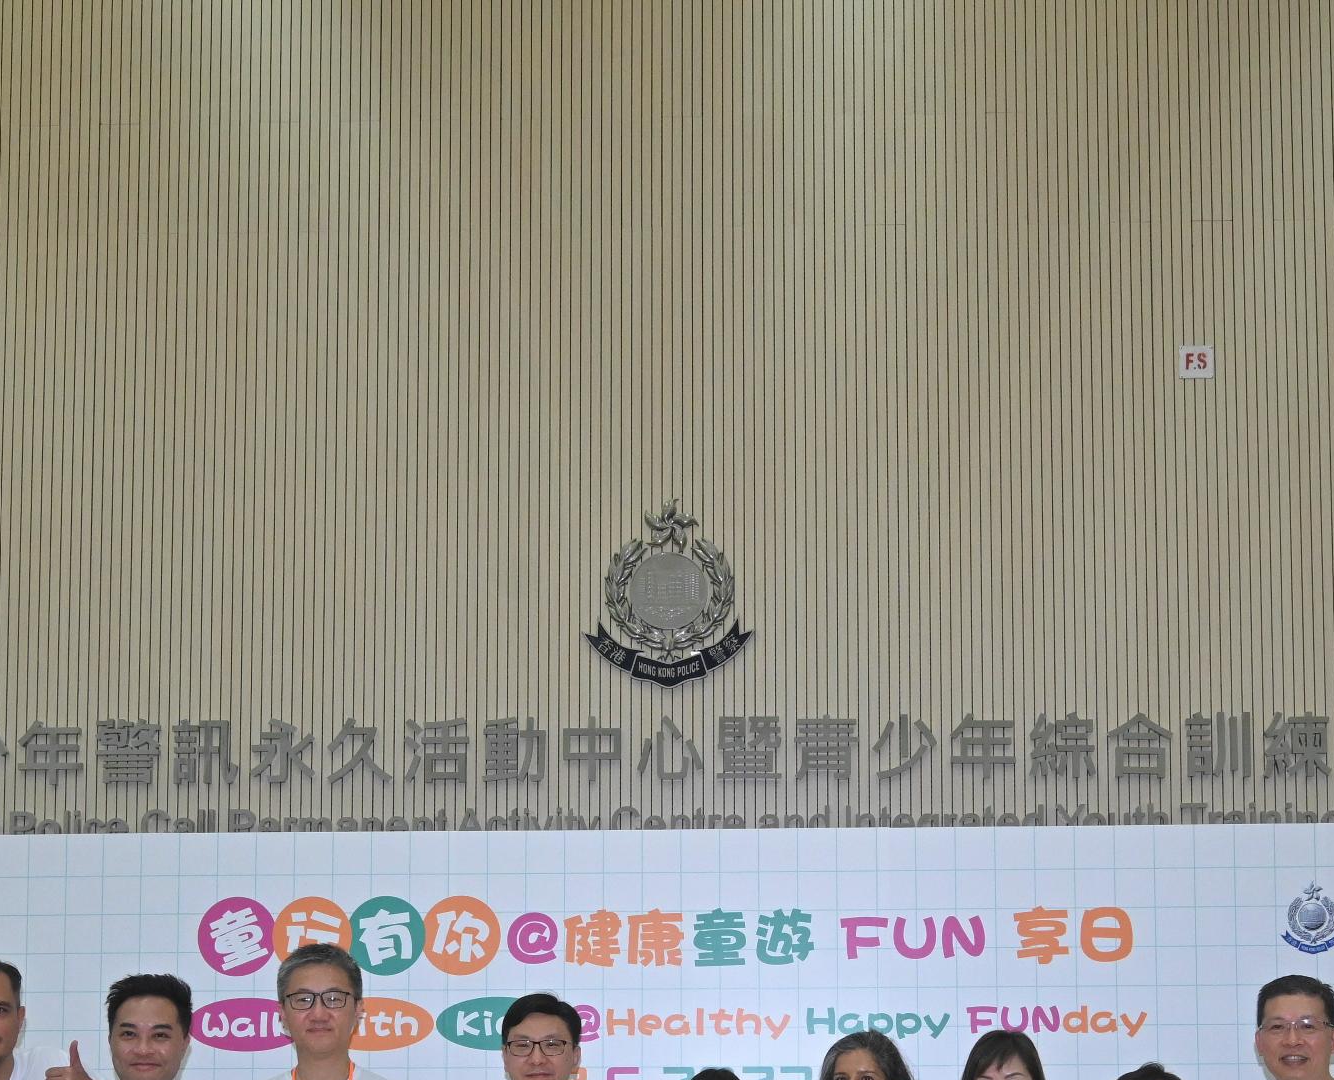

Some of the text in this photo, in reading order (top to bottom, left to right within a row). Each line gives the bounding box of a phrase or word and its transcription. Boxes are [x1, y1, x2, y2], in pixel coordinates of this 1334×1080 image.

[597, 637, 627, 665] 香港
[638, 660, 701, 679] HONG KONG POLICE
[840, 914, 987, 961] FUN
[1013, 905, 1134, 965] 享日
[357, 1010, 419, 1037] ith
[456, 1010, 505, 1037] Ki
[806, 1006, 951, 1039] Happy
[966, 1004, 1148, 1038] FUNday
